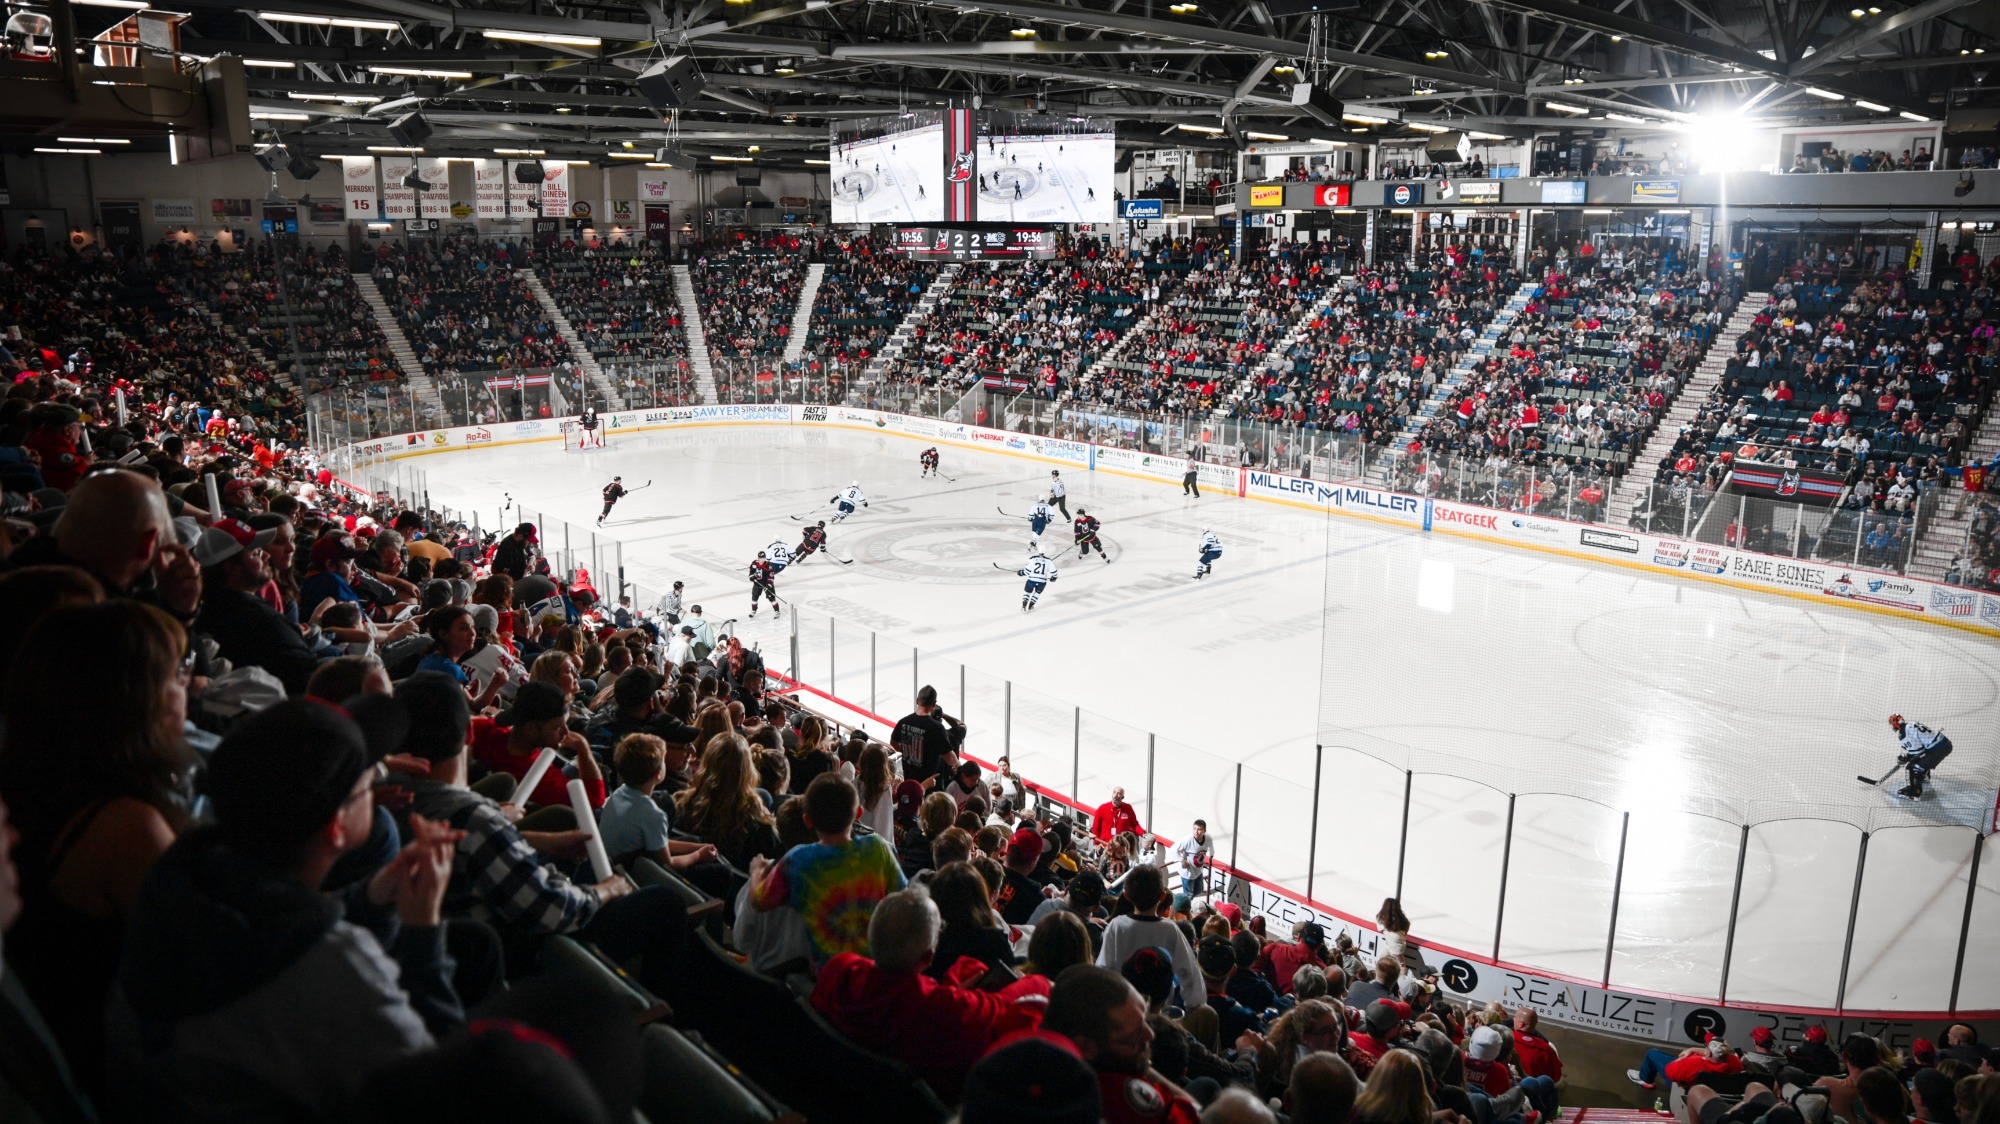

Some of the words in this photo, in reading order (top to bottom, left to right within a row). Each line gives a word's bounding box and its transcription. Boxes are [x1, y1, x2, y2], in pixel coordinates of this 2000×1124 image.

[345, 185, 375, 193] MERKOSKY
[547, 183, 561, 191] BILL
[1460, 183, 1488, 192] Andersen
[420, 192, 449, 200] CHAMPIONS
[542, 190, 567, 198] DINEEN
[1323, 187, 1339, 206] G
[352, 199, 370, 210] 15
[576, 220, 582, 228] F
[1138, 220, 1145, 228] C
[1276, 214, 1284, 224] B
[1442, 215, 1452, 226] A
[1643, 216, 1655, 228] X
[112, 226, 130, 234] THIS
[275, 222, 284, 230] H
[429, 221, 438, 229] G
[536, 222, 555, 232] OUR
[1079, 224, 1091, 232] ACE
[900, 231, 923, 243] 19:56
[954, 234, 964, 247] 2
[970, 234, 981, 247] 2
[1015, 231, 1042, 243] 19:56
[693, 406, 741, 418] SAWYER
[741, 405, 789, 413] STREAMLINED
[804, 406, 821, 414] FAST
[741, 412, 790, 420] GRAPHICS
[802, 413, 827, 422] TWITCH
[210, 426, 226, 437] 24
[515, 422, 542, 432] HILLTOP
[939, 428, 967, 441] Sylvamo
[978, 432, 1005, 442] MEERKAT
[1044, 439, 1086, 453] STREAMLINED
[1043, 445, 1086, 461] GRAPHICS
[1104, 449, 1136, 460] PHINNEY
[1150, 456, 1184, 468] PHINNEY
[1200, 464, 1236, 476] PHINNEY
[1251, 472, 1315, 496] MILLER
[848, 490, 857, 499] 8
[1346, 487, 1418, 513] MILLER
[1434, 506, 1498, 531] SEATGEEK
[1526, 522, 1560, 534] Gallagher
[1658, 541, 1681, 551] BETTER
[773, 547, 787, 558] 23
[1655, 548, 1669, 557] THAN
[1669, 551, 1683, 559] NEW
[1696, 547, 1720, 557] BETTER
[1692, 555, 1705, 563] THAN
[1706, 557, 1721, 565] NEW
[1033, 562, 1046, 575] 21
[1734, 556, 1773, 577] BARE
[1777, 563, 1825, 585] BONES
[1733, 571, 1775, 583] FURNITURE
[1783, 580, 1824, 591] MATTRESS
[1882, 581, 1915, 595] Family
[1934, 595, 1957, 605] LOCAL
[1959, 595, 1972, 604] 773
[1503, 973, 1657, 1026] REALIZE
[1570, 1015, 1654, 1035] CONSULTANTS
